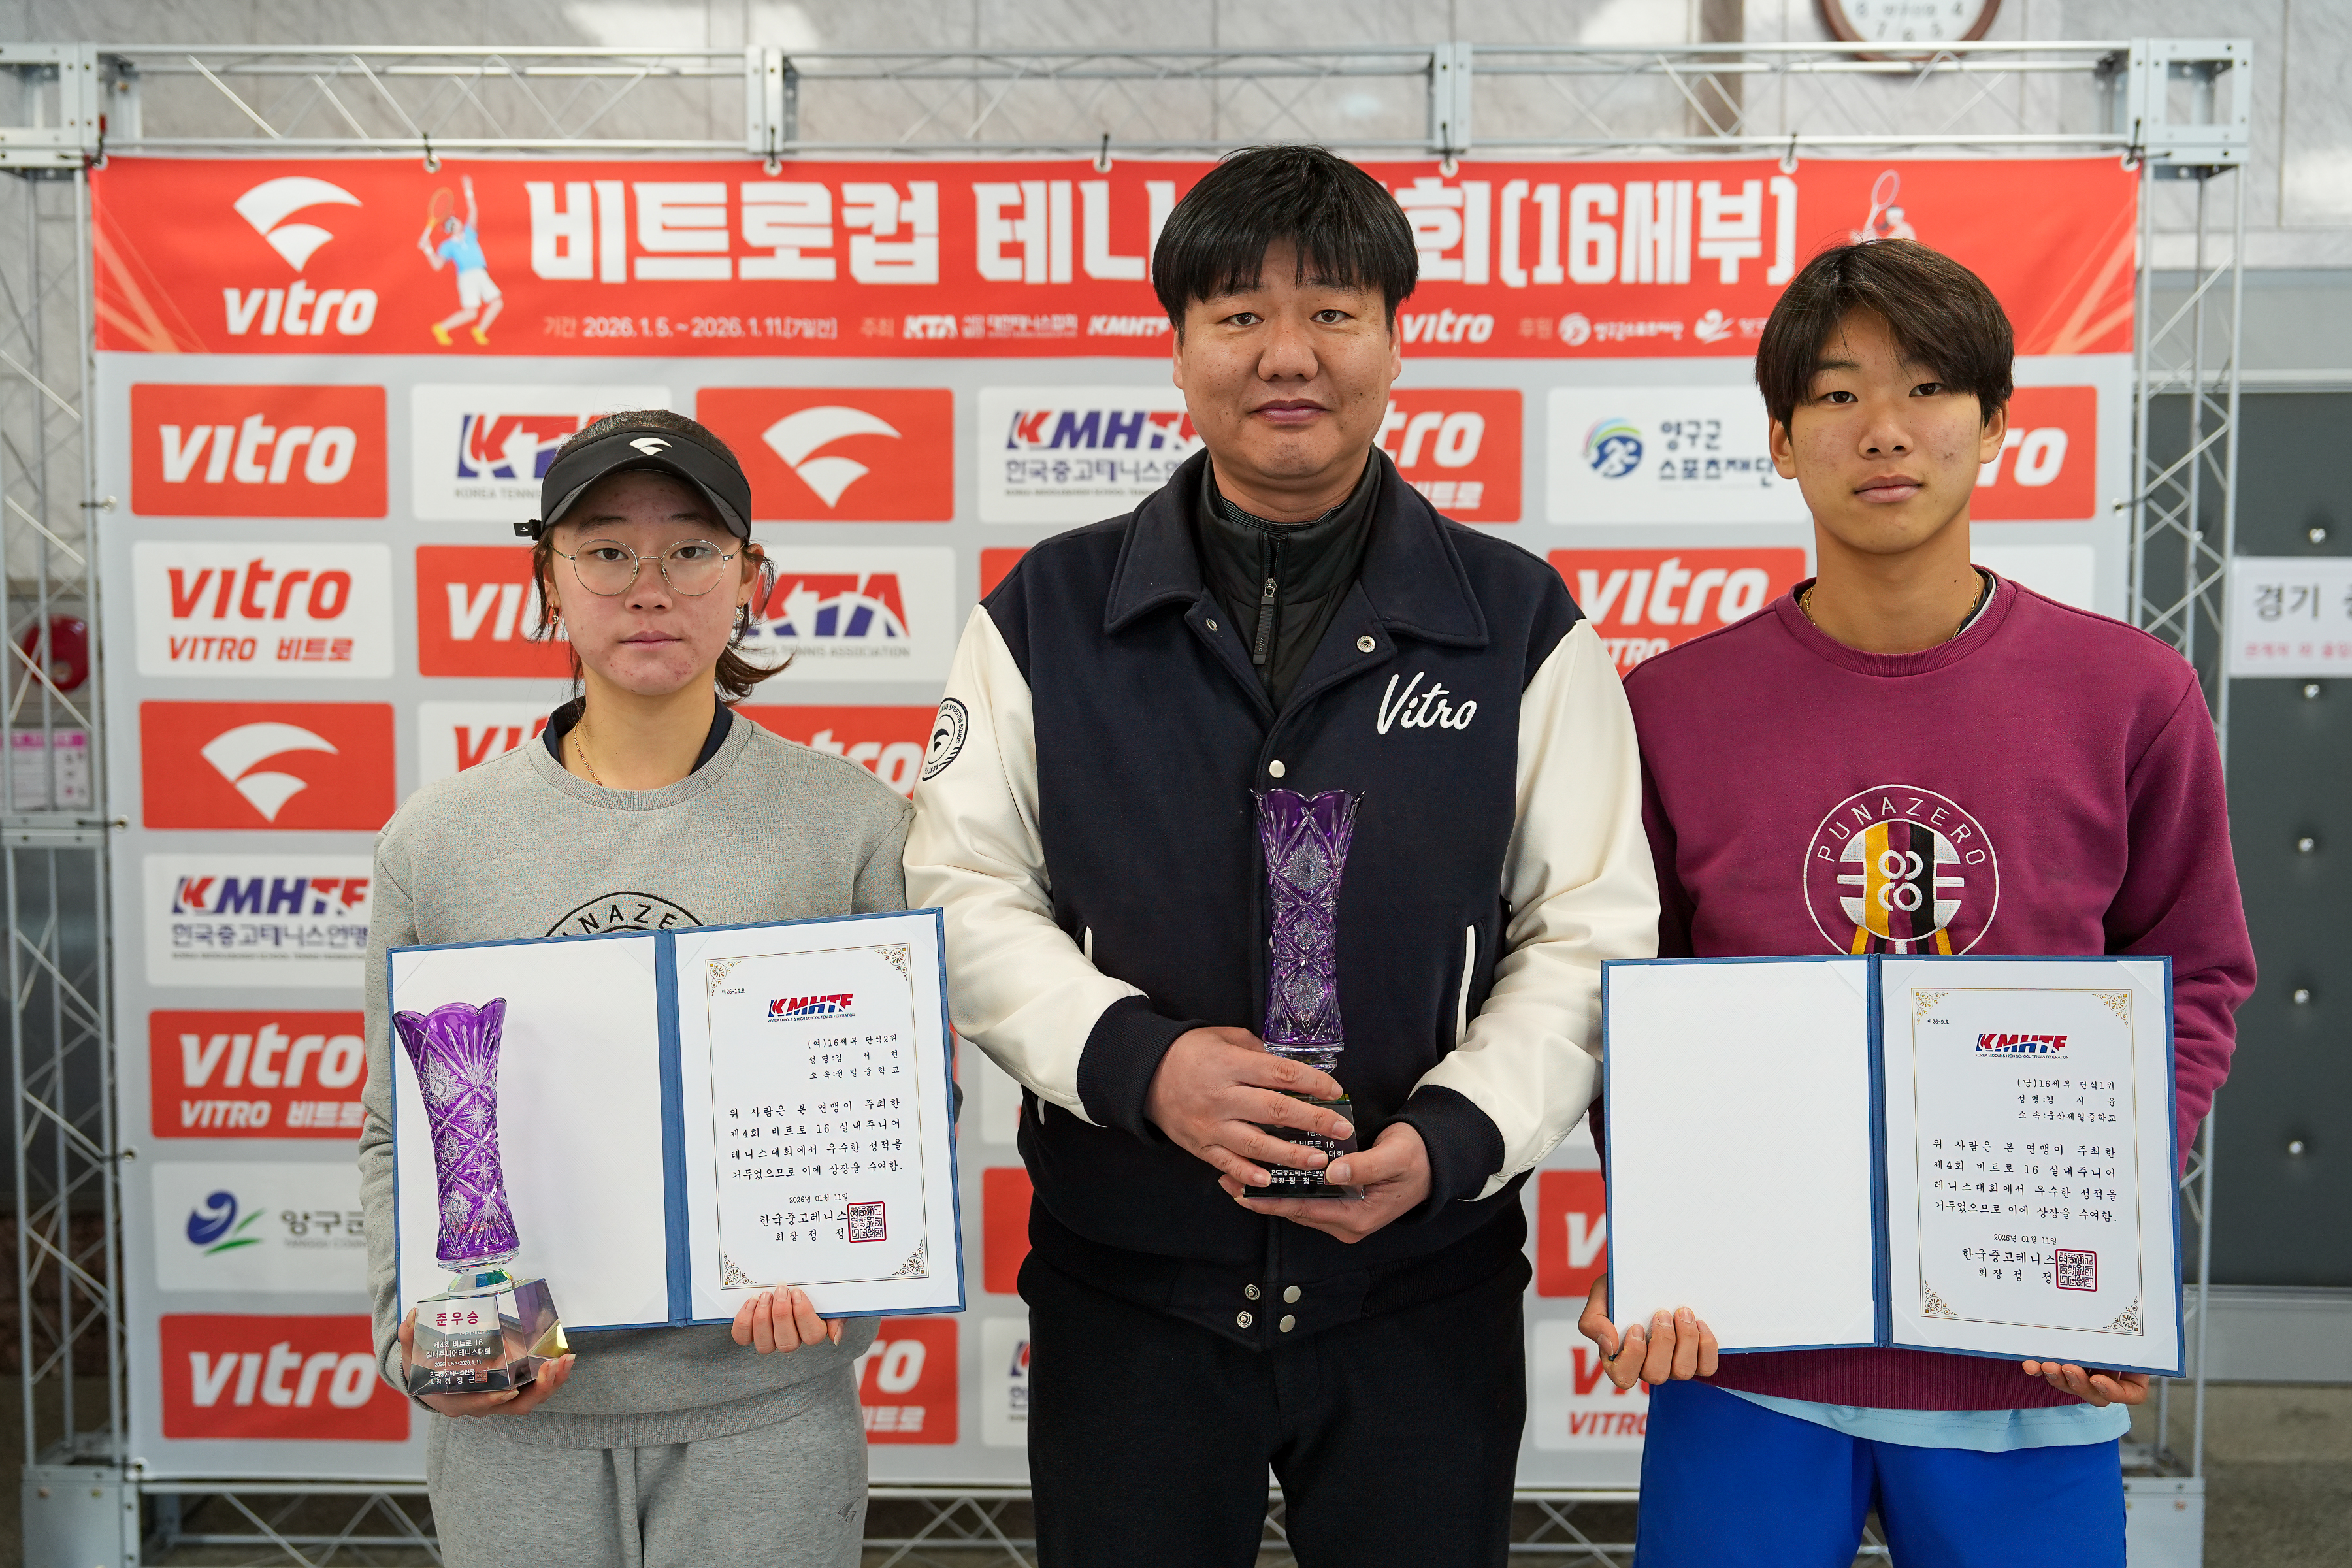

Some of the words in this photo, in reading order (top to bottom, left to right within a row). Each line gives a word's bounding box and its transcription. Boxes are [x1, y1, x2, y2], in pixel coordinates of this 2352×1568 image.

[524, 180, 940, 284] 비트로컵
[223, 280, 378, 335] vitro
[1401, 308, 1495, 343] vitro
[1373, 399, 1486, 468] tro
[159, 413, 357, 485] vitro
[457, 414, 588, 478] KT
[1007, 459, 1183, 483] 한국중고테니스연
[168, 557, 352, 621] vitro
[1577, 557, 1770, 625] vitro
[2254, 582, 2319, 621] 경기
[169, 636, 257, 661] VITRO
[276, 637, 353, 661] 비트로
[1377, 671, 1477, 735] Vitro
[1817, 796, 1985, 865] PUNAZERO
[172, 877, 370, 915] KMHTF
[768, 994, 853, 1017] KMHTF
[866, 1034, 897, 1045] 단식2위
[1975, 1034, 2068, 1053] KMHTF
[179, 1022, 365, 1089] vitro
[179, 1100, 271, 1129] VITRO
[729, 1107, 738, 1119] 위
[751, 1105, 786, 1118] 사람은
[797, 1103, 807, 1115] 본
[817, 1100, 853, 1114] 연맹이
[864, 1098, 901, 1109] 주최한
[730, 1127, 760, 1139] 제4회
[771, 1125, 807, 1137] 비트로
[816, 1124, 830, 1134] 16
[839, 1117, 901, 1133] 실내주니어
[731, 1144, 818, 1160] 테니스대회에서
[826, 1141, 861, 1154] 우수한
[868, 1138, 903, 1152] 성적을
[1933, 1138, 1942, 1150] 위
[1954, 1139, 1992, 1152] 사람은
[2004, 1142, 2014, 1153] 본
[2026, 1143, 2064, 1156] 연맹이
[2076, 1145, 2116, 1159] 주최한
[732, 1166, 796, 1181] 거두었으므로
[802, 1164, 822, 1176] 이에
[828, 1162, 861, 1175] 상장을
[866, 1160, 904, 1172] 수여함.
[1933, 1159, 1964, 1171] 제4회
[1976, 1161, 2014, 1173] 비트로
[2024, 1164, 2039, 1175] 16
[2049, 1164, 2116, 1180] 실내주니어
[789, 1195, 811, 1203] 2026년
[815, 1194, 830, 1202] 01월
[834, 1192, 849, 1201] 11일
[1934, 1179, 2025, 1196] 테니스대회에서
[2034, 1184, 2071, 1199] 우수한
[2080, 1187, 2117, 1201] 성적을
[1935, 1200, 2001, 1215] 거두었으므로
[2008, 1204, 2029, 1217] 이에
[2036, 1206, 2071, 1220] 상장을
[2078, 1209, 2117, 1223] 수여함.
[1993, 1233, 2017, 1243] 2026년
[2021, 1235, 2037, 1244] 01월
[2042, 1237, 2057, 1246] 11일
[436, 1310, 479, 1327] 준우승
[426, 1347, 491, 1359] 실내주니어테니스대회
[453, 1339, 472, 1348] 비트로
[188, 1341, 376, 1408] vitro
